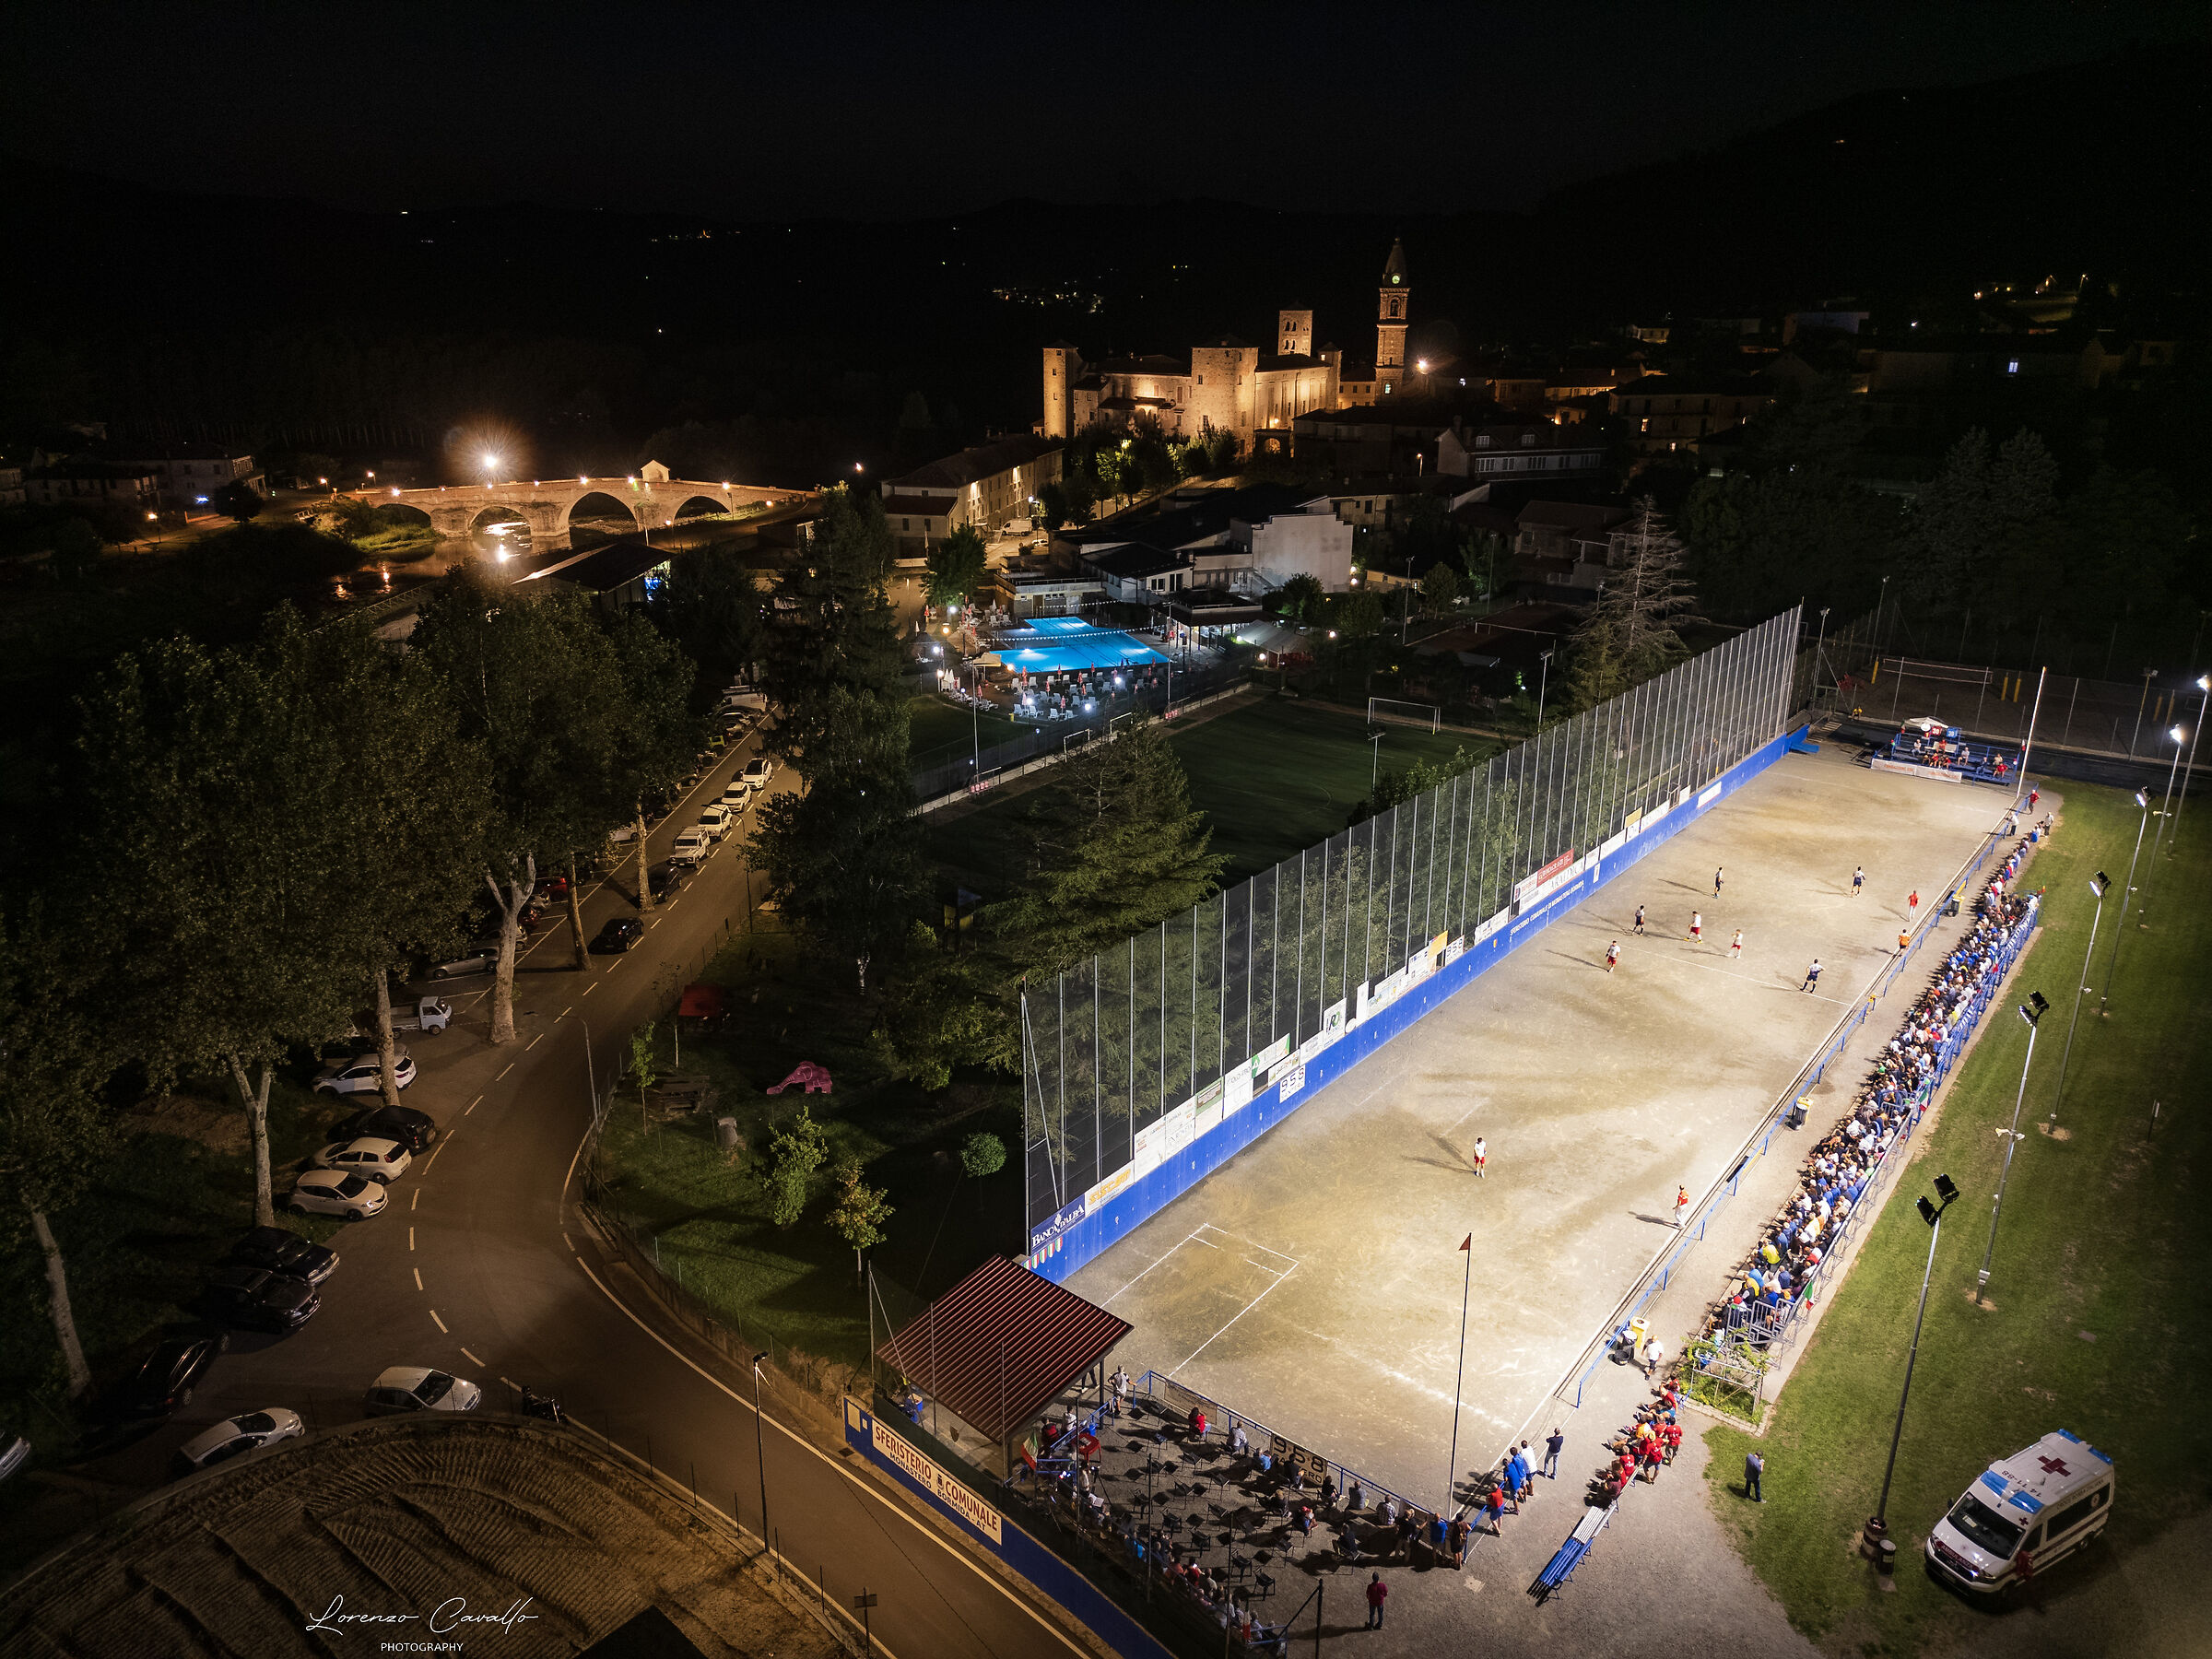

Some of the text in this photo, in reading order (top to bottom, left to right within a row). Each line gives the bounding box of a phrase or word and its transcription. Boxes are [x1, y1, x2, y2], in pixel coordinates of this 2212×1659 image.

[1032, 1225, 1060, 1248] BANCA
[876, 1426, 997, 1532] SFERISTERIO COMUNALE
[889, 1452, 932, 1488] MONASTERO
[937, 1489, 971, 1520] BORMIDA
[976, 1521, 986, 1531] AT
